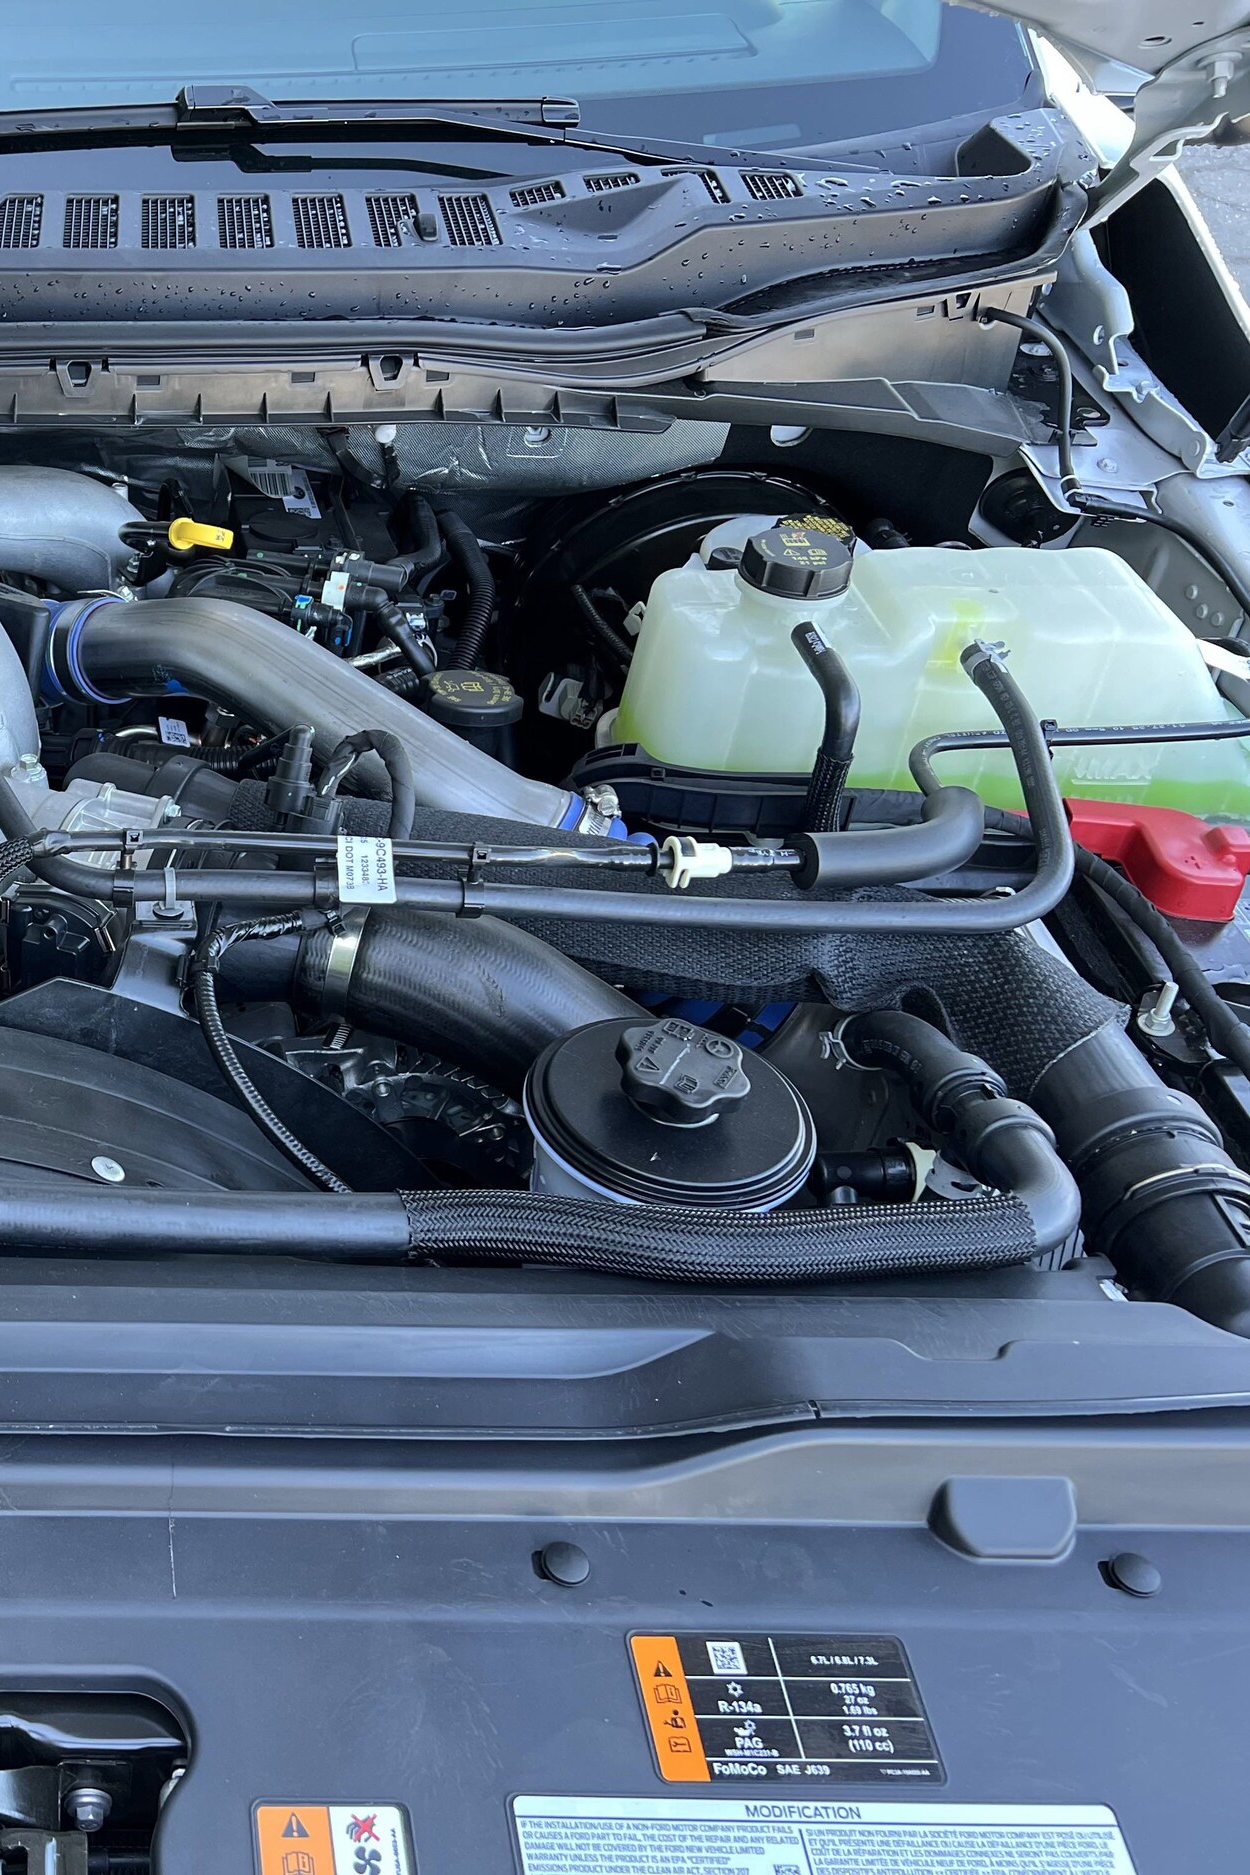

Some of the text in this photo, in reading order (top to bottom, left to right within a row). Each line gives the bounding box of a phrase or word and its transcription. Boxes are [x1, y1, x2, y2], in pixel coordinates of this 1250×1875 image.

[345, 846, 353, 863] DOT
[830, 1682, 876, 1697] 0.765 kg
[717, 1701, 762, 1713] R-134a
[856, 1696, 870, 1705] oz
[842, 1705, 879, 1715] 1.69 lbs
[842, 1725, 890, 1737] 3.7 fl oz
[734, 1737, 764, 1749] PAG
[848, 1739, 894, 1754] (110 cc)
[712, 1762, 830, 1776] FoMoCo SAE J639
[745, 1804, 861, 1820] MODIFICATION
[530, 1821, 543, 1829] THE
[632, 1823, 670, 1831] NON-FORD
[671, 1823, 699, 1832] MOTOR
[700, 1824, 734, 1833] COMPANY
[736, 1825, 771, 1833] PRODUCT
[772, 1825, 793, 1834] FAILS
[534, 1831, 562, 1840] CAUSES
[571, 1832, 590, 1840] FORD
[591, 1832, 610, 1841] PART
[623, 1833, 640, 1841] FAIL,
[642, 1833, 657, 1842] THE
[658, 1834, 677, 1842] COST
[689, 1834, 704, 1843] THE
[705, 1835, 730, 1843] REPAIR
[733, 1835, 748, 1844] AND
[750, 1836, 765, 1844] ANY
[766, 1836, 799, 1844] RELATED
[524, 1842, 556, 1850] DAMAGE
[556, 1842, 573, 1851] WILL
[575, 1843, 590, 1851] NOT
[603, 1843, 636, 1852] COVERED
[649, 1844, 664, 1853] THE
[665, 1845, 685, 1853] FORD
[686, 1845, 702, 1853] NEW
[704, 1845, 734, 1854] VEHICLE
[736, 1846, 765, 1855] LIMITED
[526, 1853, 567, 1862] WARRANTY
[568, 1853, 598, 1862] UNLESS
[600, 1854, 613, 1862] THE
[615, 1854, 650, 1863] PRODUCT
[671, 1856, 687, 1864] EPA
